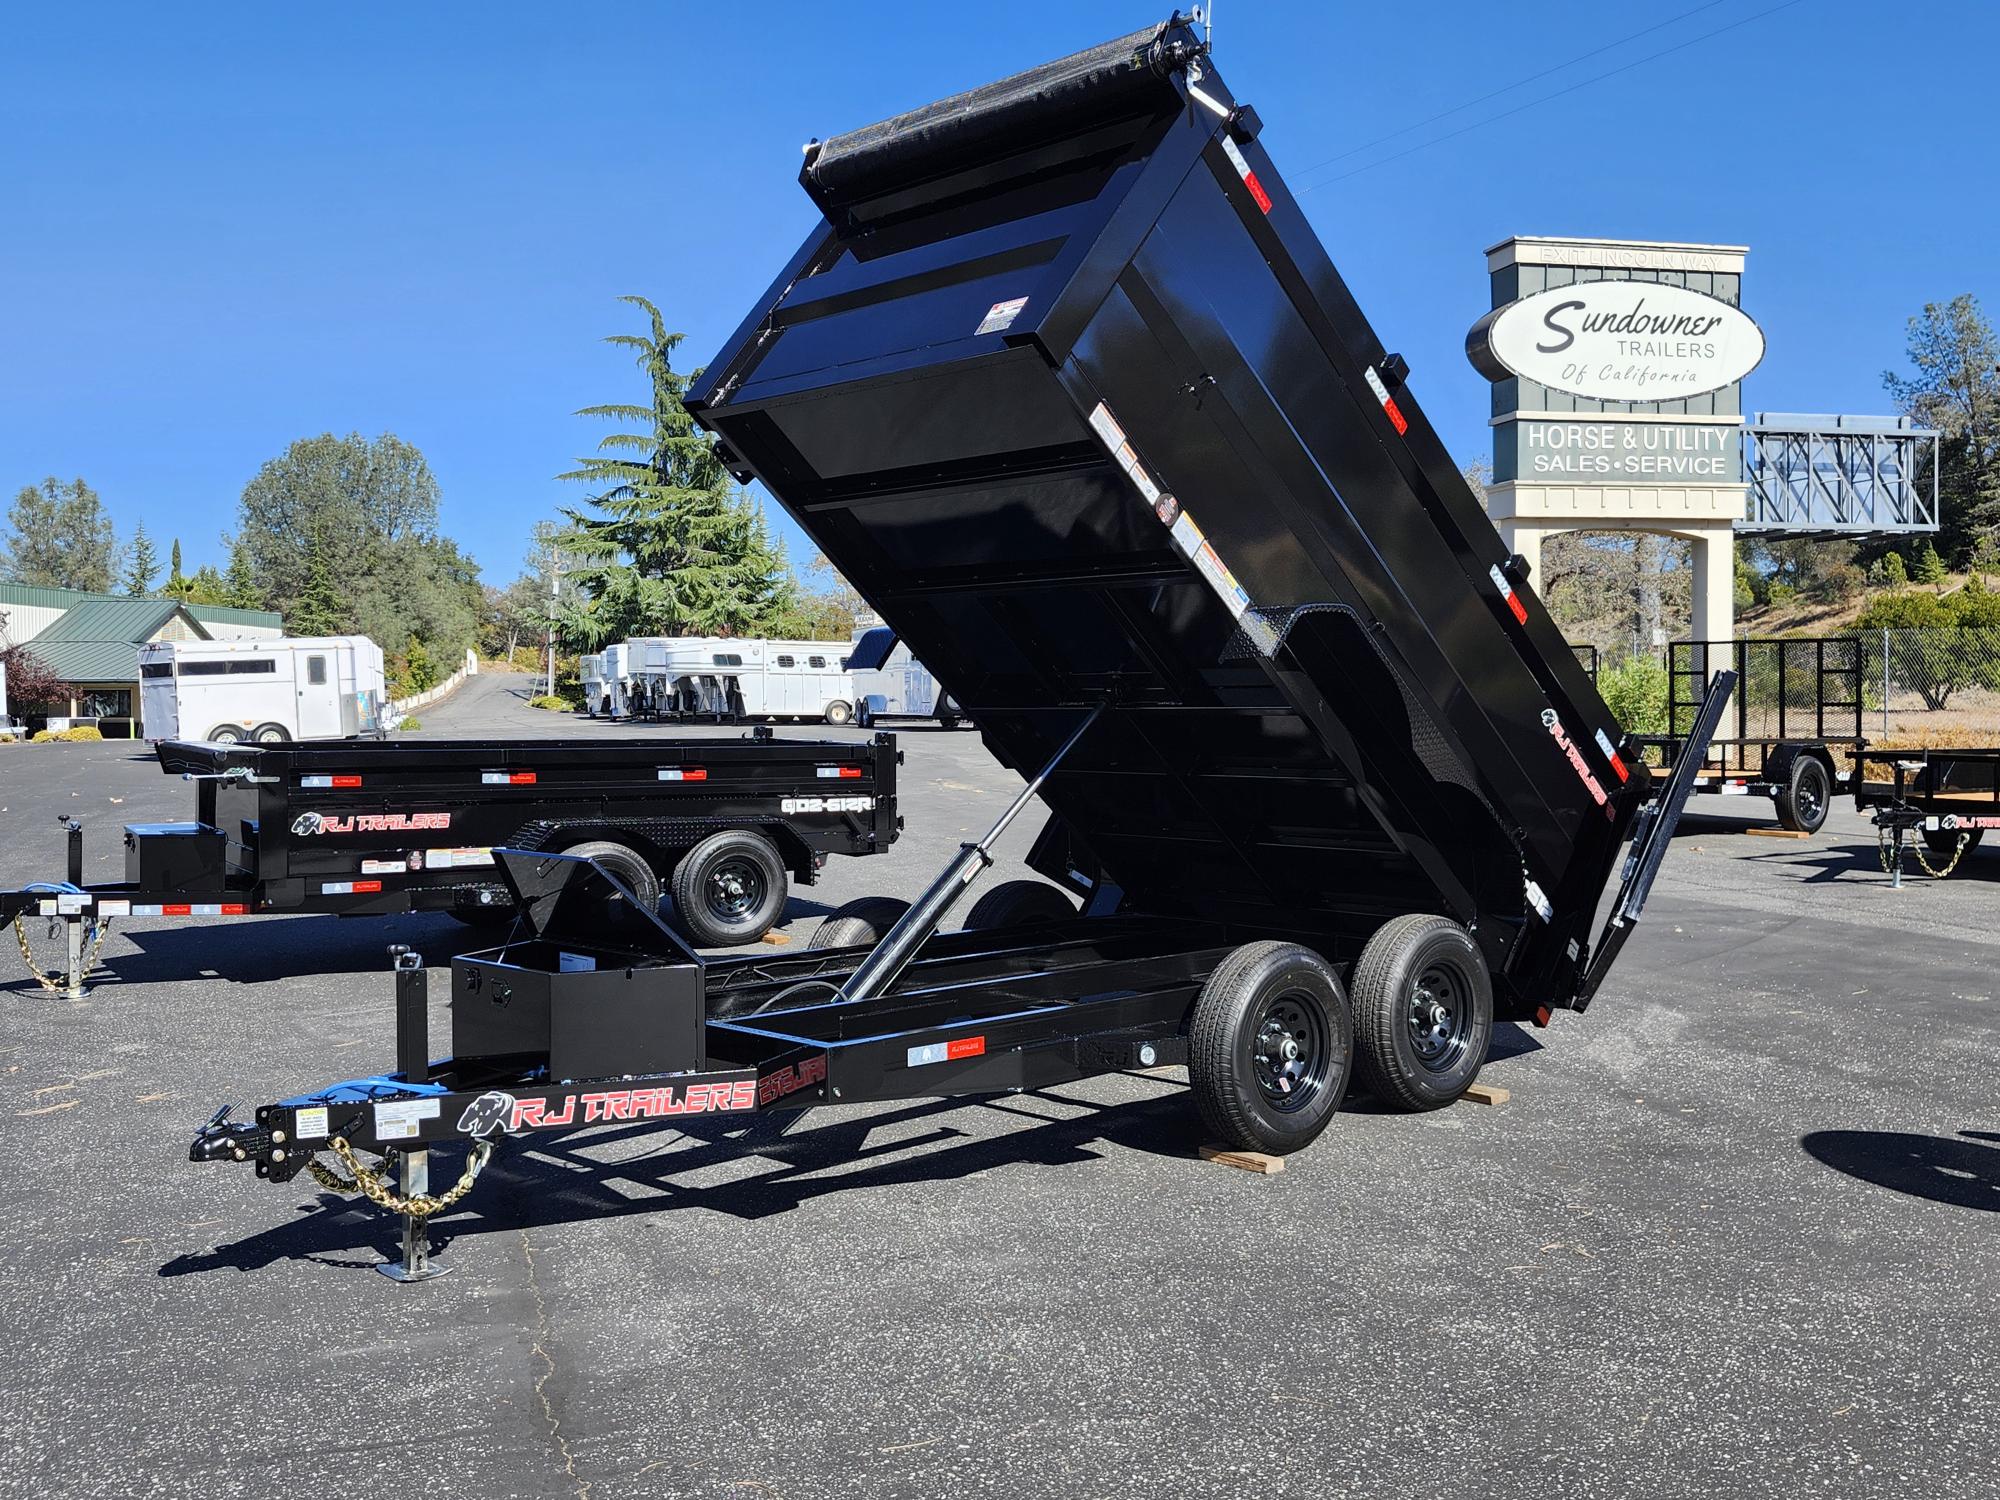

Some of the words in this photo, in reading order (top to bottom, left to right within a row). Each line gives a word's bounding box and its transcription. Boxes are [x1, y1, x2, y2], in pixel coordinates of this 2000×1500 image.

[1540, 247, 1585, 264] EXIT
[1589, 250, 1676, 268] LINCOLN
[1678, 254, 1722, 270] WAY
[1536, 298, 1723, 354] Sundowner
[1616, 340, 1715, 359] TRAILERS
[1561, 363, 1588, 385] Of
[1598, 364, 1697, 386] California
[1528, 425, 1616, 449] HORSE
[1623, 427, 1638, 449] &
[1643, 427, 1730, 450] UTILITY
[1534, 455, 1610, 473] SALES
[1625, 456, 1726, 475] SERVICE
[319, 816, 354, 832] RJ
[356, 812, 451, 832] TRAILERS
[511, 1095, 576, 1129] RJ
[580, 1080, 758, 1123] TRAILERS
